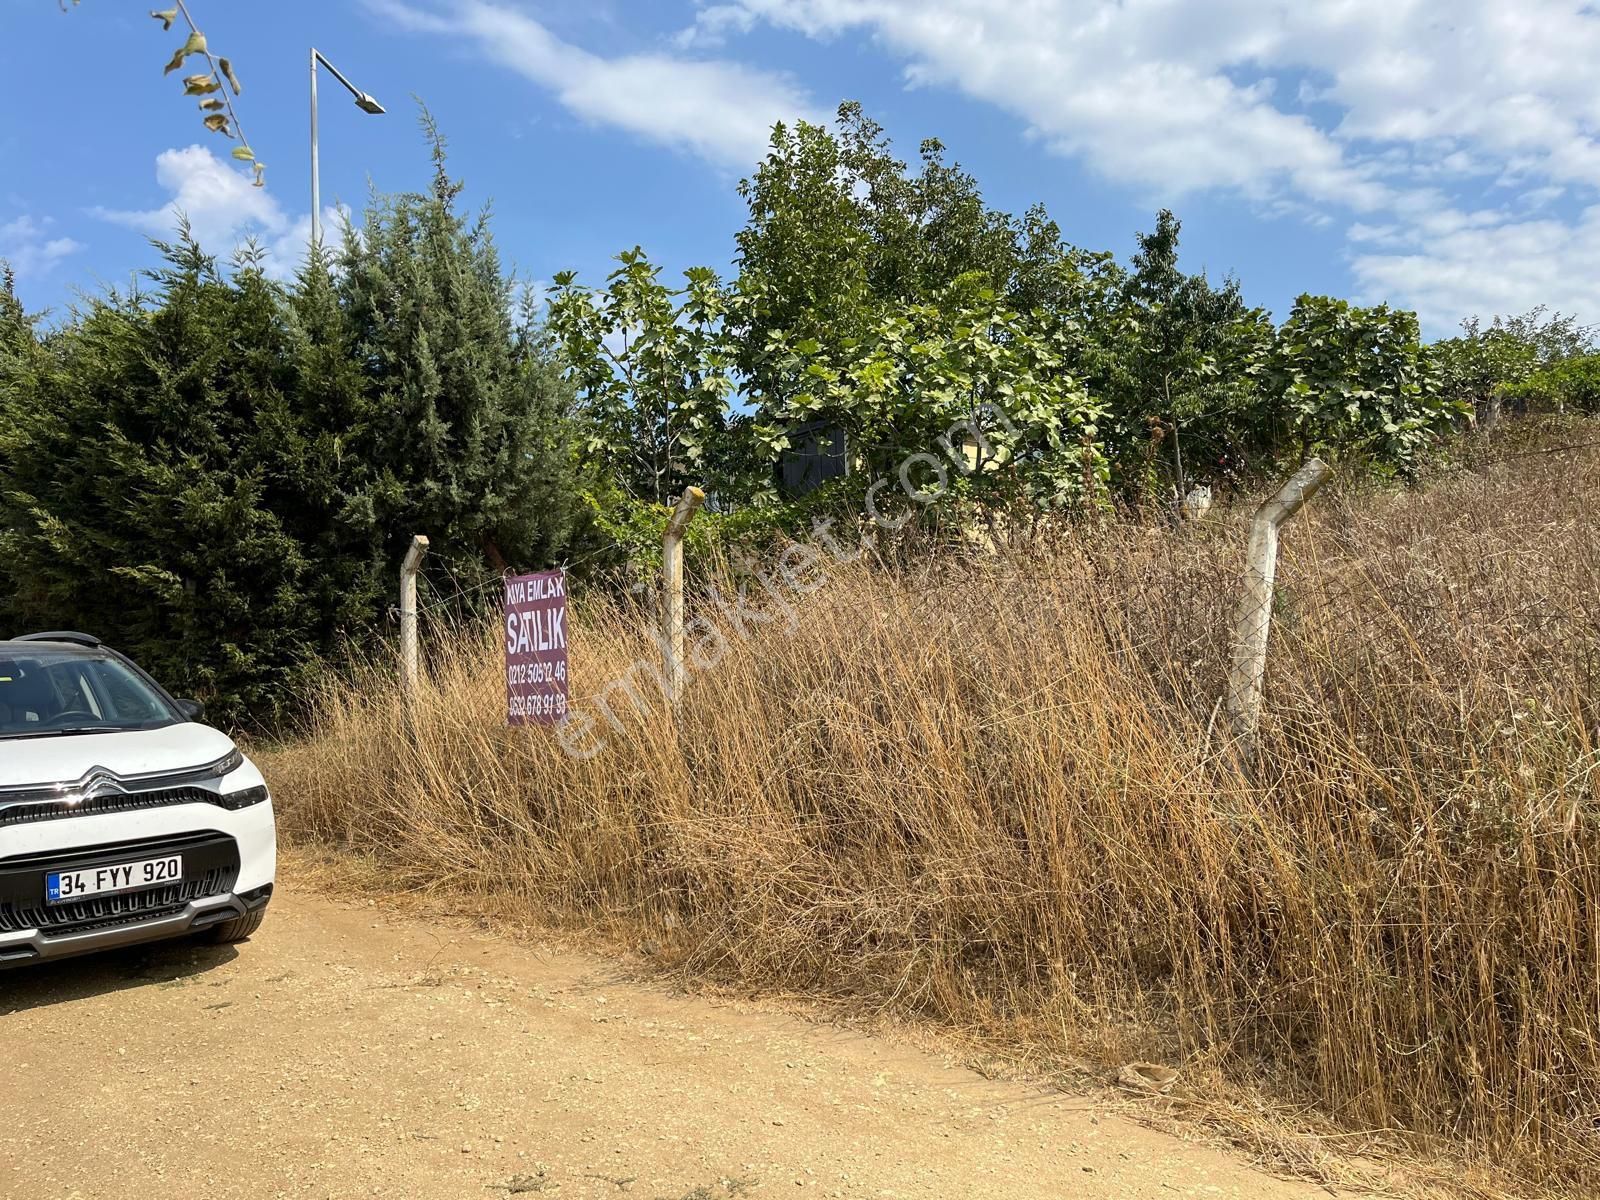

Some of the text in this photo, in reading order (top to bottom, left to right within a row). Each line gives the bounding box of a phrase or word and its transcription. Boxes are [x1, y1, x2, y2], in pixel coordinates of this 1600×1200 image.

[528, 577, 565, 603] EMLAK
[507, 607, 565, 655] SATILIK
[508, 664, 526, 685] 0212
[555, 660, 566, 682] 46
[527, 695, 542, 715] 678
[543, 694, 554, 715] 91
[61, 873, 86, 895] 34
[96, 865, 133, 890] FYY
[143, 858, 178, 882] 920
